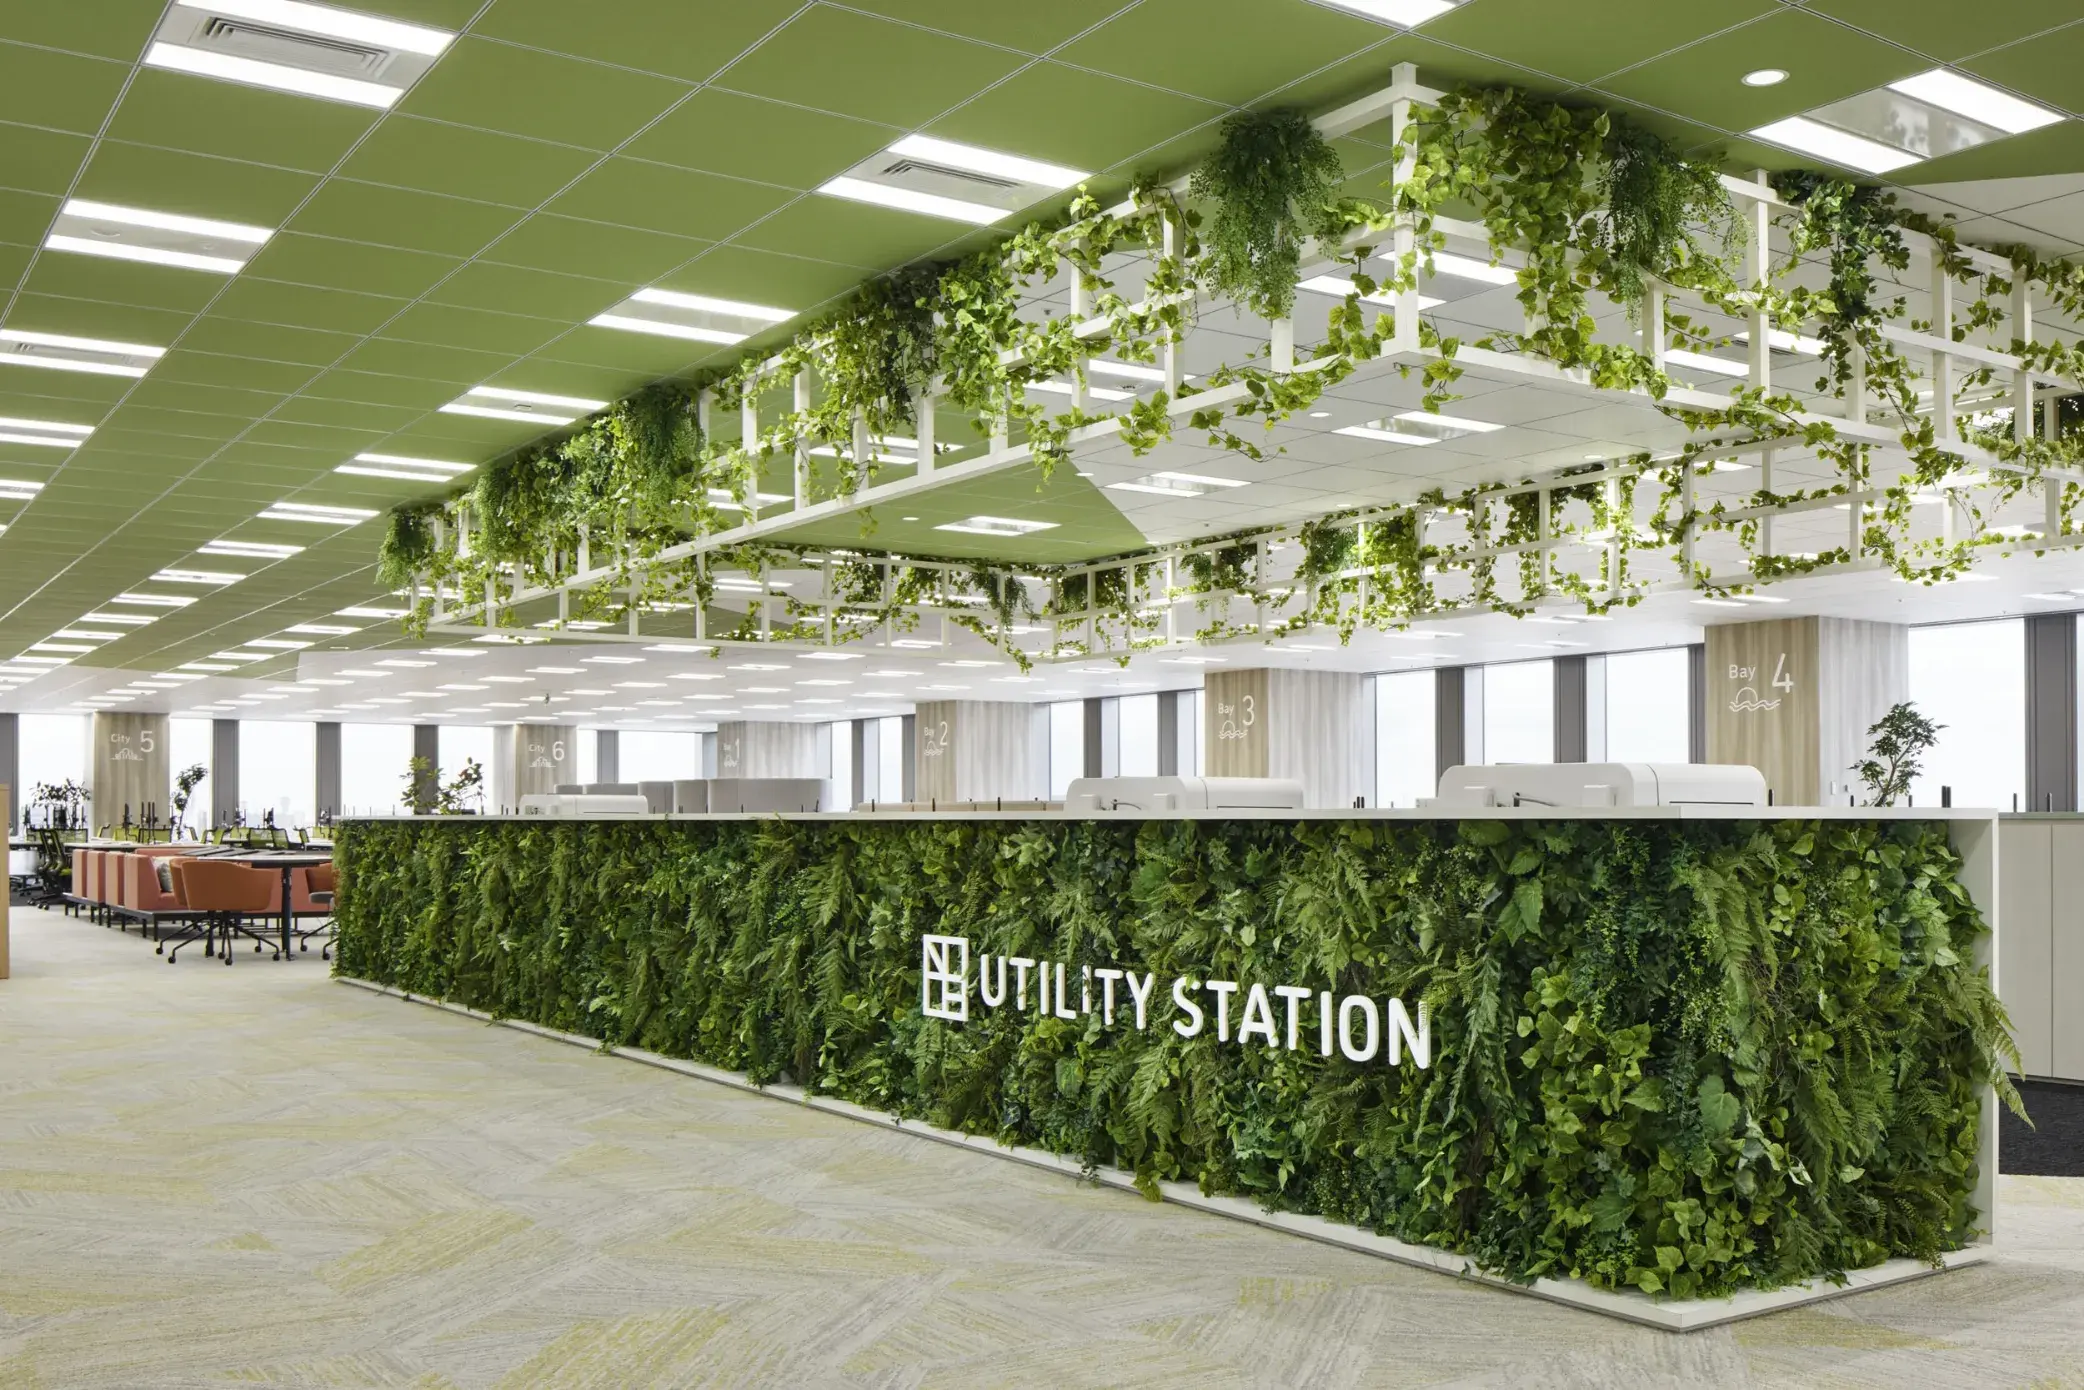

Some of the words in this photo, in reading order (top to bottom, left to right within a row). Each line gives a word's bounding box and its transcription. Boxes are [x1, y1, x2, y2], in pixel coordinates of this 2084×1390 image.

[1729, 664, 1756, 682] Bay
[1772, 653, 1794, 693] 4
[1218, 703, 1234, 716] Bay
[1242, 695, 1254, 726] 3
[110, 733, 131, 744] City
[140, 730, 154, 752] 5
[940, 721, 948, 745] 2
[552, 741, 565, 761] 6
[980, 953, 1156, 1030] UTILITY
[1172, 974, 1432, 1070] STATION
